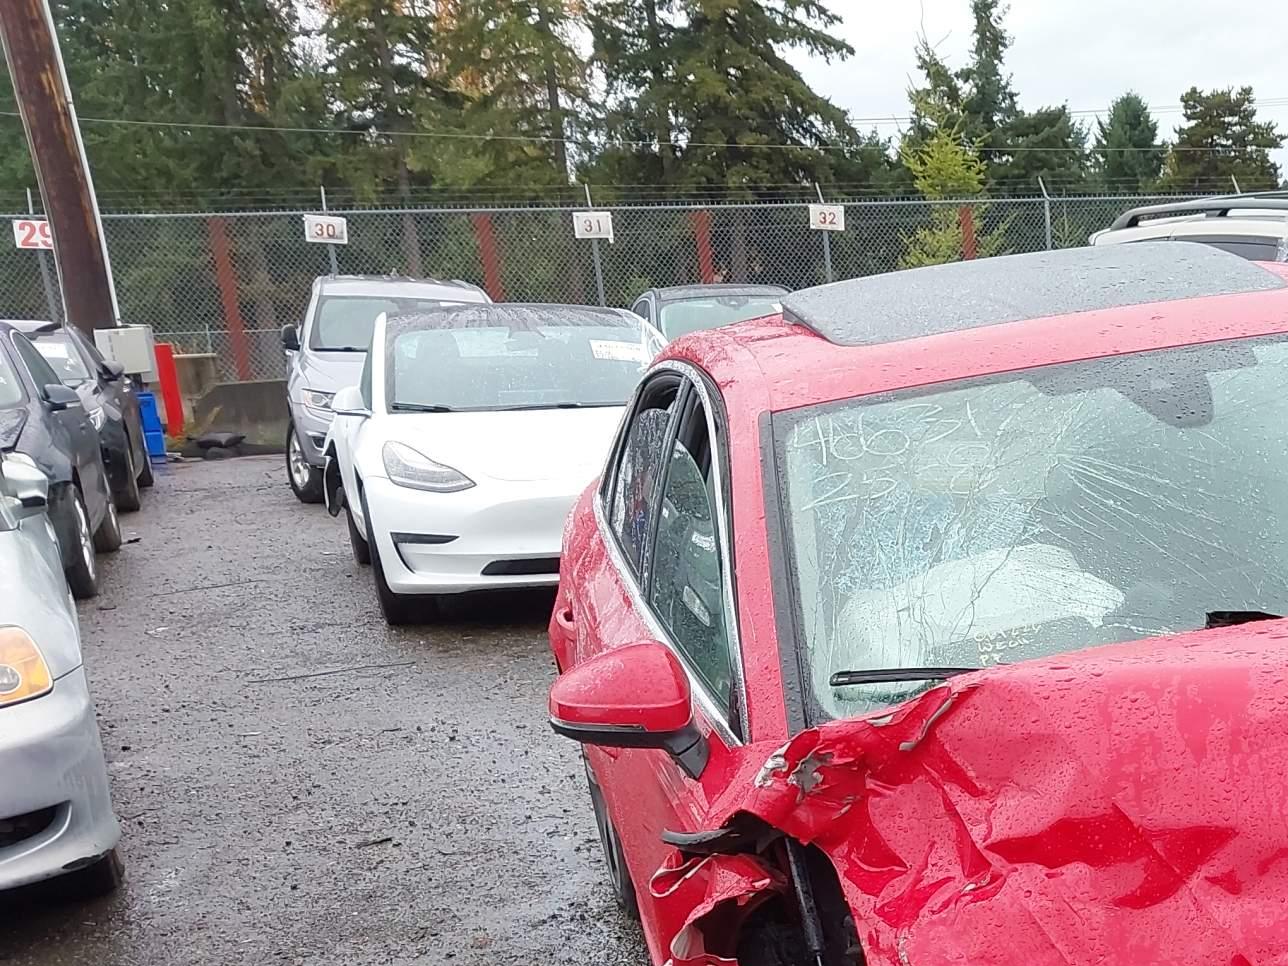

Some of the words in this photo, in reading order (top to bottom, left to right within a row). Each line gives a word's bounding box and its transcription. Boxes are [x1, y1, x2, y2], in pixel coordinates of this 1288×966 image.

[819, 211, 837, 225] 32
[315, 223, 335, 237] 30
[584, 219, 601, 233] 31
